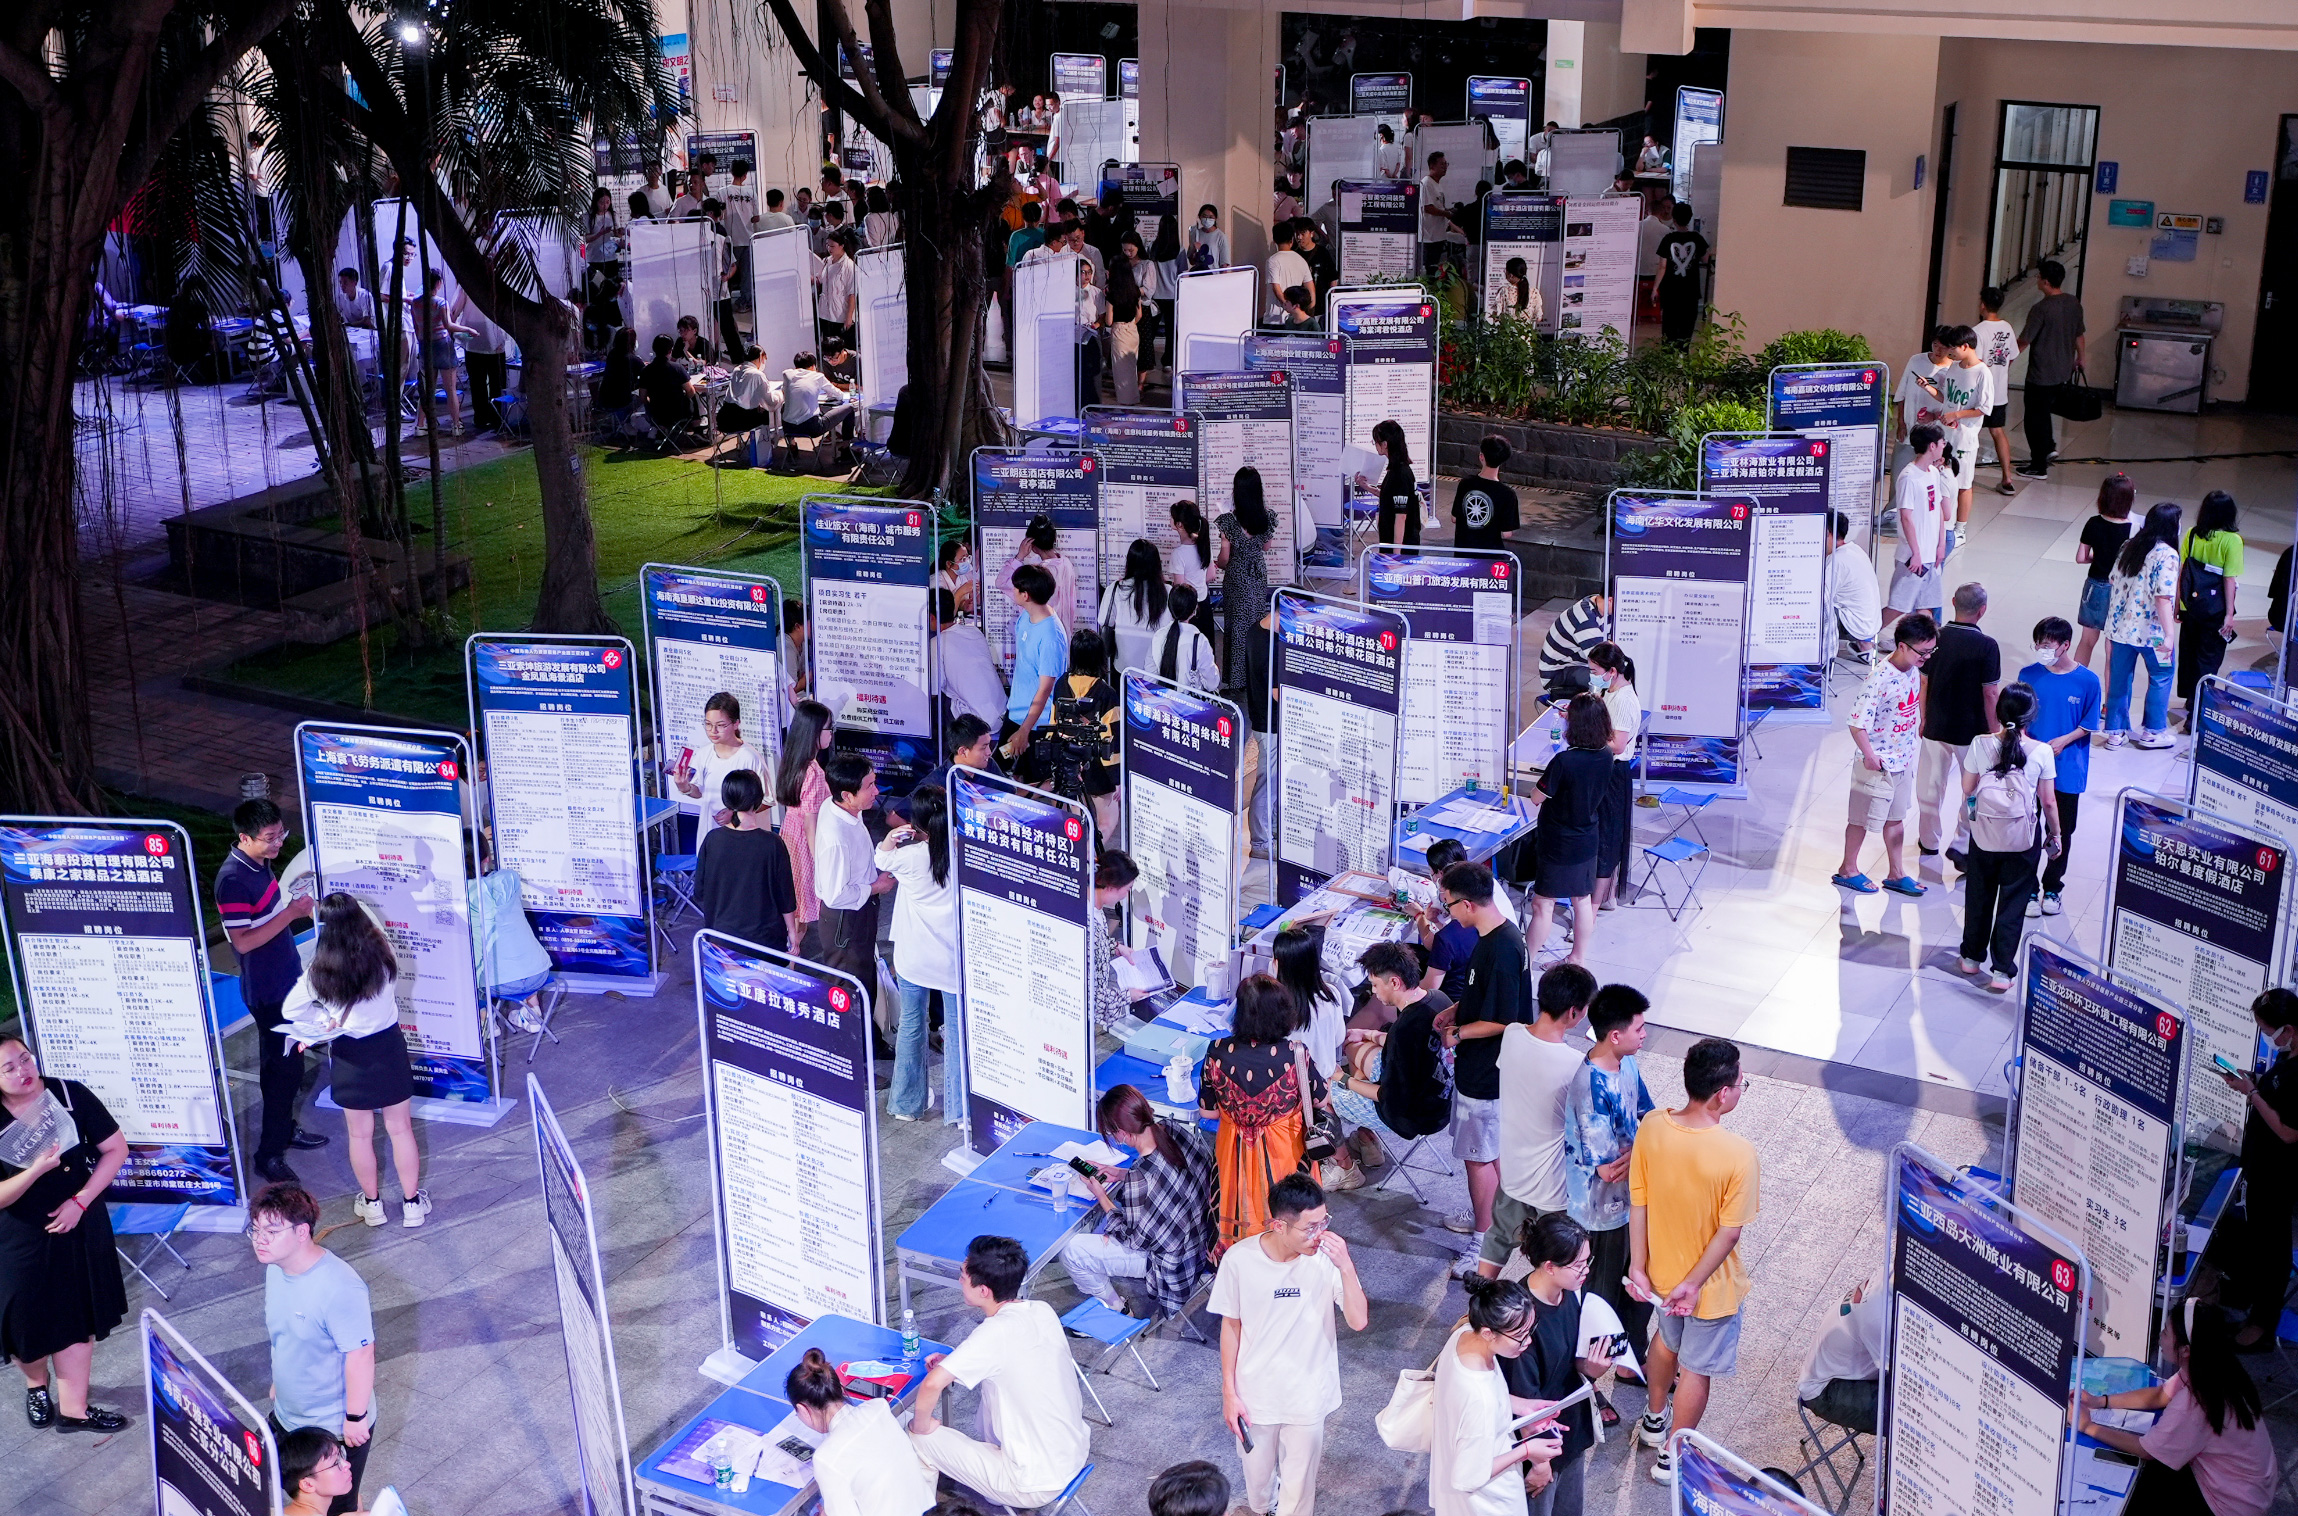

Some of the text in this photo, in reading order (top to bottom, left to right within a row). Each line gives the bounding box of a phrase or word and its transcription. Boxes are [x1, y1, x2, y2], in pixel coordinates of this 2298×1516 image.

[1421, 307, 1430, 315] 76
[1330, 343, 1338, 351] 77
[1272, 373, 1281, 382] 78
[1864, 373, 1873, 382] 75
[1176, 421, 1185, 430] 79
[1813, 444, 1823, 454] 74
[1082, 460, 1092, 471] 80
[1721, 456, 1815, 467] 三亚林海旅业有限公司
[1711, 467, 1824, 478] 三亚湾海居铂尔曼度假酒店
[1019, 479, 1056, 489] 君亭酒店
[909, 514, 918, 525] 81
[1734, 506, 1744, 518] 73
[1625, 515, 1743, 531] 海南亿华文化发展有限公司
[841, 533, 894, 546] 有限责任公司
[1495, 565, 1505, 576] 72
[1666, 570, 1696, 578] 招聘岗位
[1374, 573, 1507, 590] 三亚南山普门旅游发展有限公司
[752, 589, 763, 600] 82
[1383, 635, 1392, 647] 71
[1285, 631, 1395, 669] 有限公司希尔顿花园酒店
[605, 652, 619, 666] 83
[521, 672, 585, 684] 金凤凰海景酒店
[857, 693, 887, 704] 福利待遇
[1220, 720, 1229, 734] 70
[1162, 726, 1200, 751] 有限公司
[315, 749, 442, 774] 上海袁飞劳务派遣有限公
[441, 764, 455, 777] 84
[1067, 822, 1078, 837] 69
[149, 838, 163, 852] 85
[964, 823, 1080, 871] 教育投资有限责任公司
[13, 853, 175, 869] 三亚海泰投资管理有限公司
[2138, 828, 2265, 886] 三亚天恩实业有限公司
[2259, 853, 2272, 868] 61
[29, 868, 164, 883] 泰康之家臻品之选酒店
[2155, 850, 2244, 895] 铂尔曼度假酒店
[84, 925, 123, 934] 招聘岗位
[2175, 918, 2208, 938] 招聘岗位
[725, 978, 840, 1029] 三亚唐拉雅秀酒店
[831, 990, 845, 1008] 68
[2040, 974, 2167, 1051] 三亚龙环环卫环境工程有限公司
[2159, 1016, 2172, 1036] 62
[769, 1069, 804, 1088] 招聘岗位
[2029, 1056, 2086, 1098] 储备干部 1-5名
[2079, 1062, 2112, 1087] 招聘岗位
[2095, 1094, 2145, 1131] 行政助理 1名
[150, 1122, 179, 1130] 福利待遇
[2086, 1198, 2127, 1231] 实习生 3名
[1907, 1193, 2069, 1313] 三亚西岛大洲旅业有限公司
[2055, 1264, 2070, 1288] 63
[1961, 1323, 1998, 1356] 招聘岗位
[163, 1375, 261, 1491] 海南文雅实业有限公司
[189, 1426, 239, 1485] 三亚分公司
